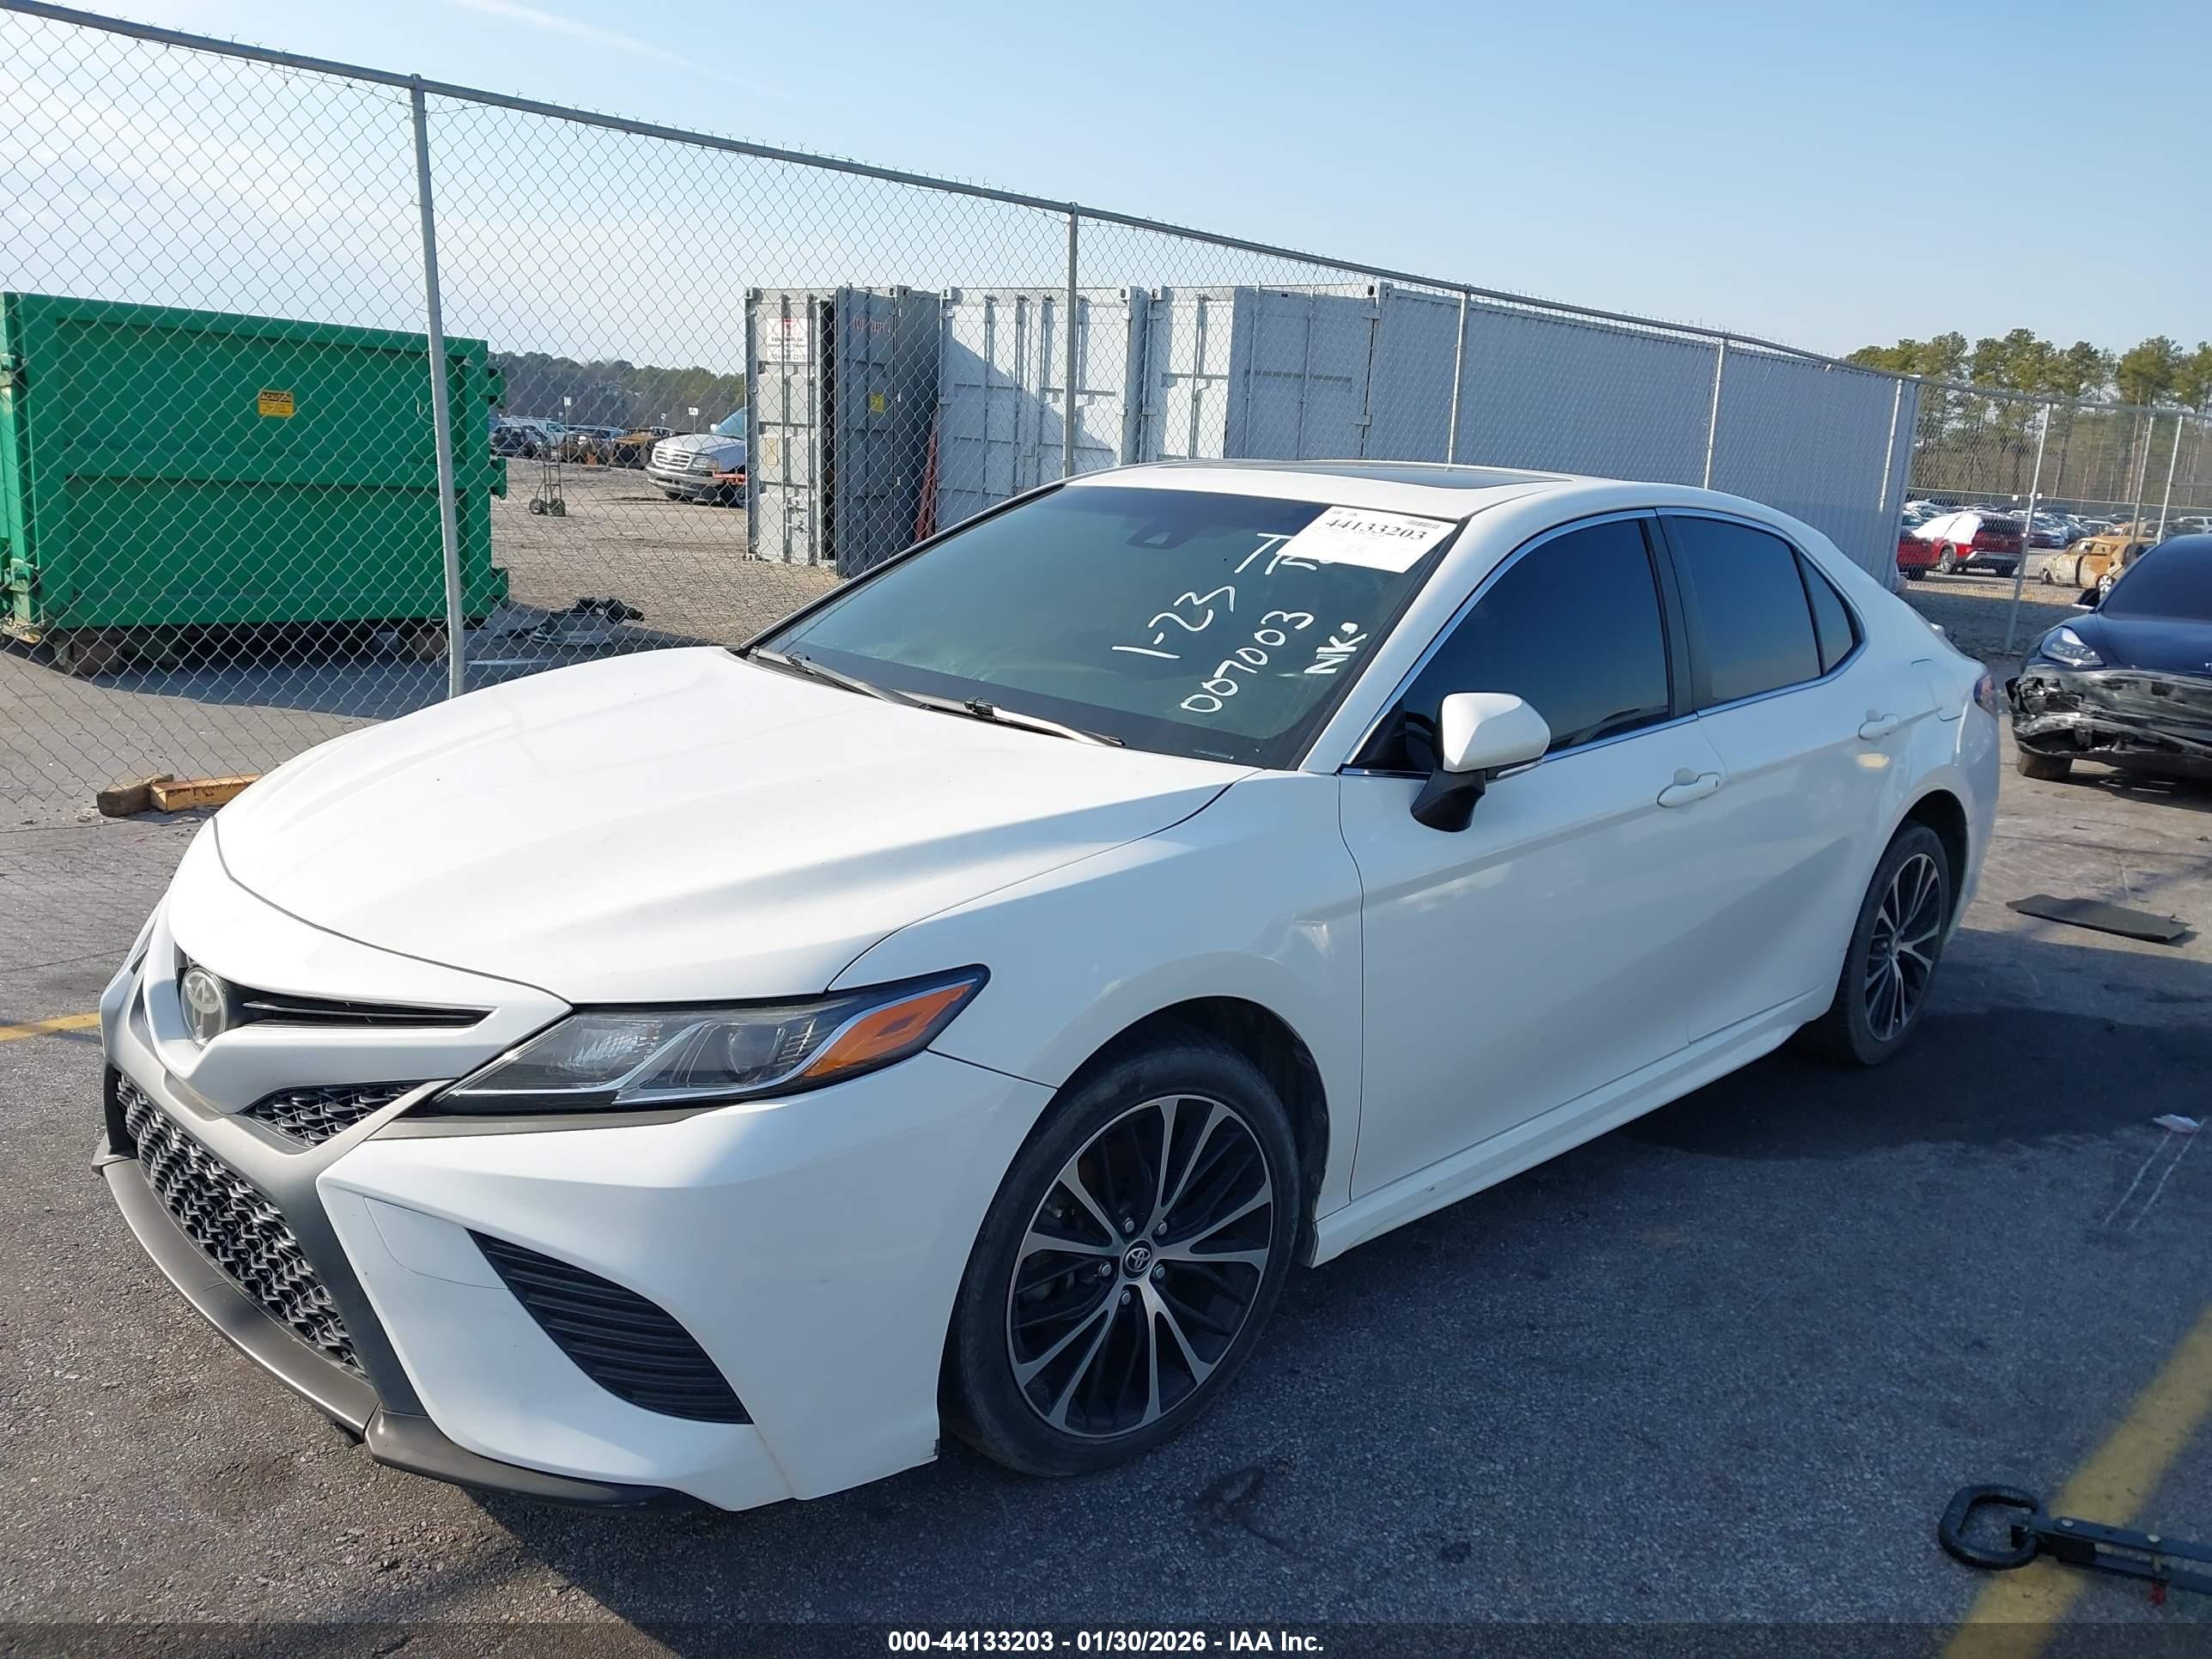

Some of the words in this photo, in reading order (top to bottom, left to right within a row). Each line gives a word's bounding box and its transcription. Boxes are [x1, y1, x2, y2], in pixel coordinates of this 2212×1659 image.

[1326, 519, 1427, 540] 44133203
[1112, 586, 1236, 659] 1-23
[1181, 611, 1315, 713] 007003
